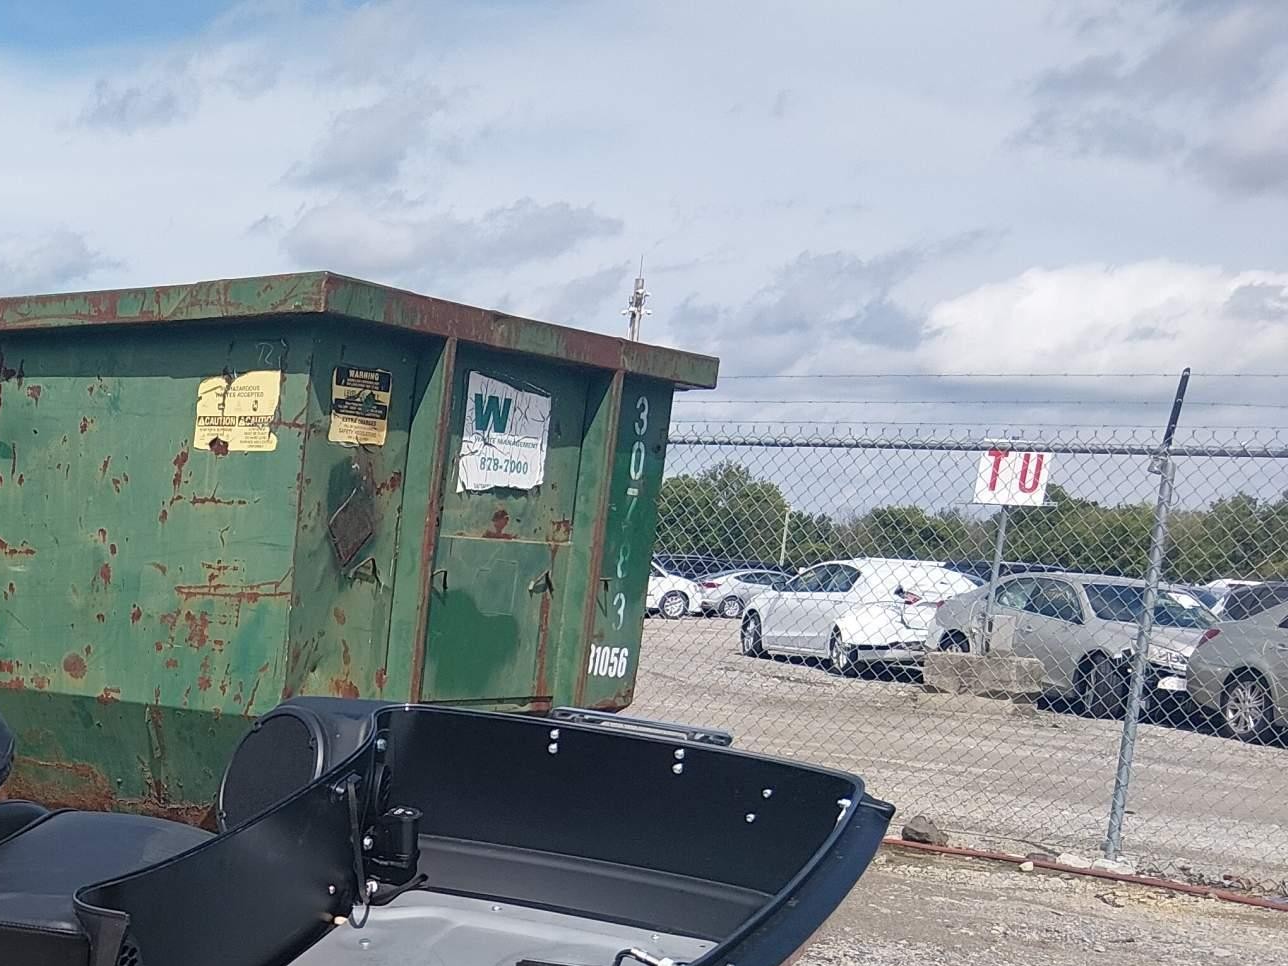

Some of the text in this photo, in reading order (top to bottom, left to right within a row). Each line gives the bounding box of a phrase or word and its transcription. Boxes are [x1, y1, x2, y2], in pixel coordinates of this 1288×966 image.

[349, 369, 380, 381] WARNING
[474, 393, 513, 433] W
[204, 416, 236, 426] CAUTION
[479, 456, 529, 475] 878-7000
